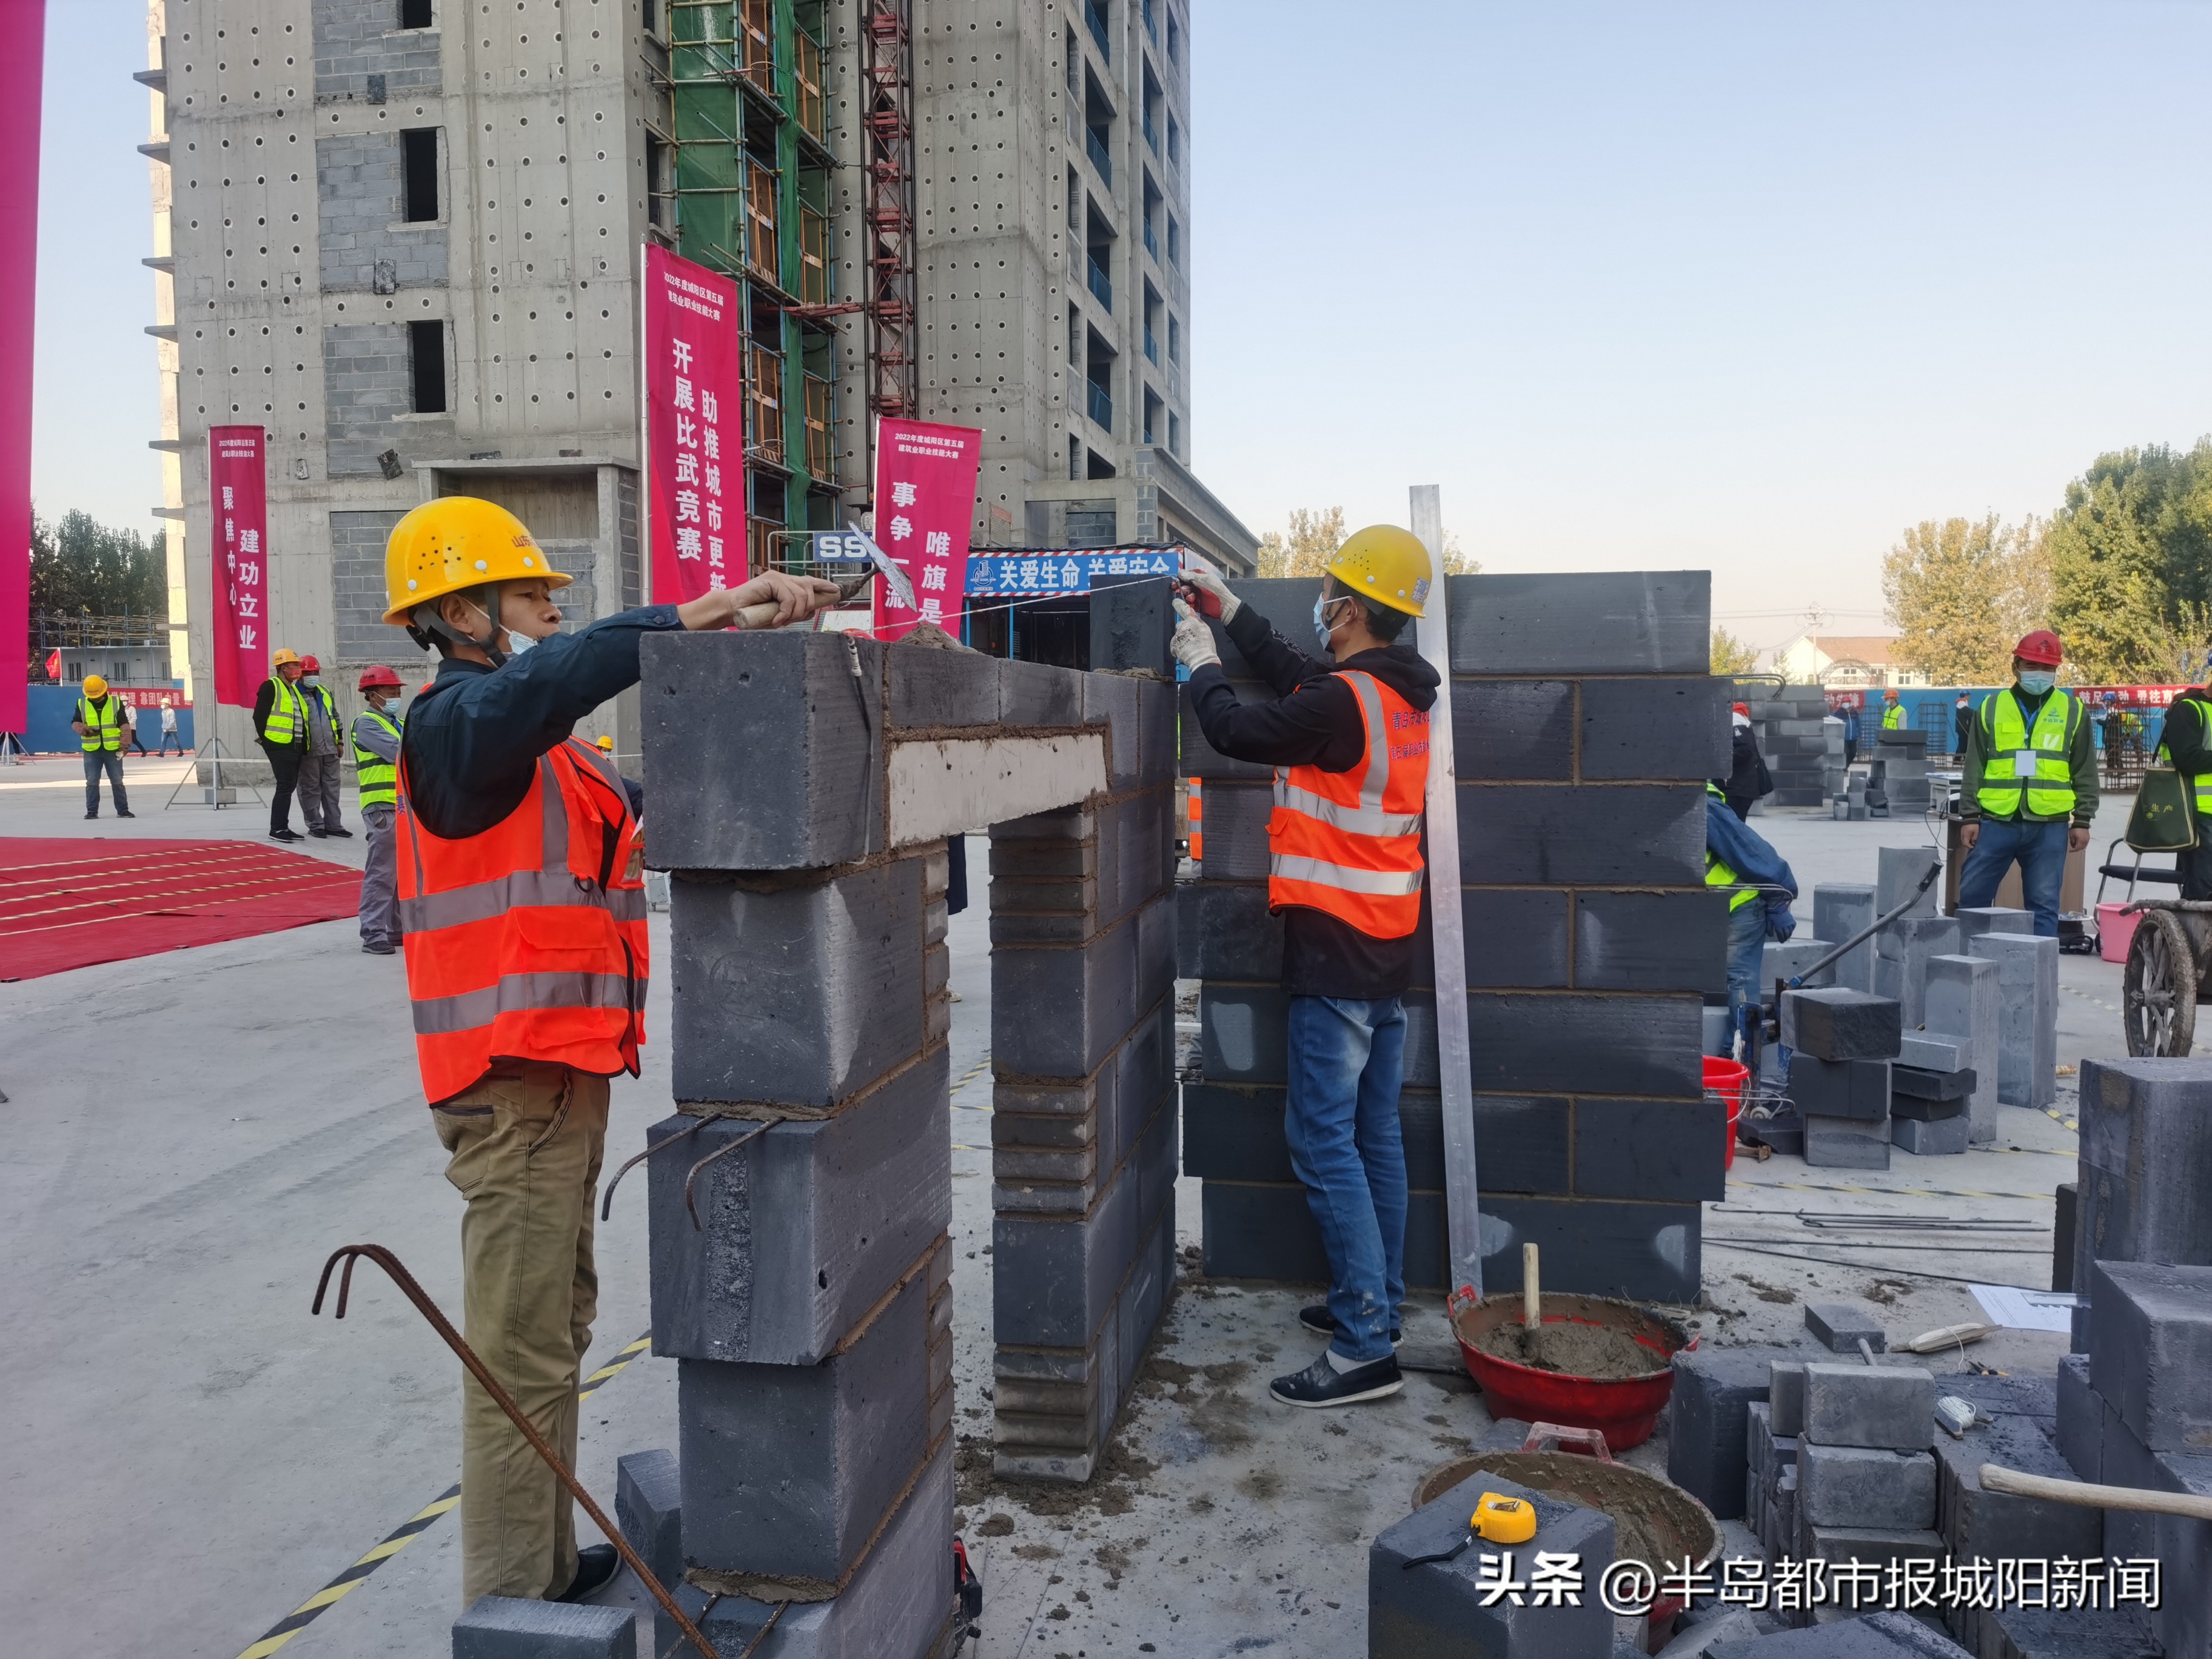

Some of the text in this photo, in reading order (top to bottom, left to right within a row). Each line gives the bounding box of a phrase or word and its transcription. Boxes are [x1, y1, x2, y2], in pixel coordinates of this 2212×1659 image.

[672, 338, 702, 561] 开展比武竞赛
[895, 433, 964, 449] 2022年度城阳区第五届
[898, 444, 959, 459] 建筑业职业技能大赛
[702, 389, 727, 592] 助推城市更新
[222, 486, 237, 606] 聚焦中心
[511, 534, 538, 547] 山东
[239, 529, 260, 649] 建功立业
[918, 531, 951, 624] 唯旗是
[999, 558, 1081, 589] 关爱生命
[2137, 689, 2185, 705] 勇往直
